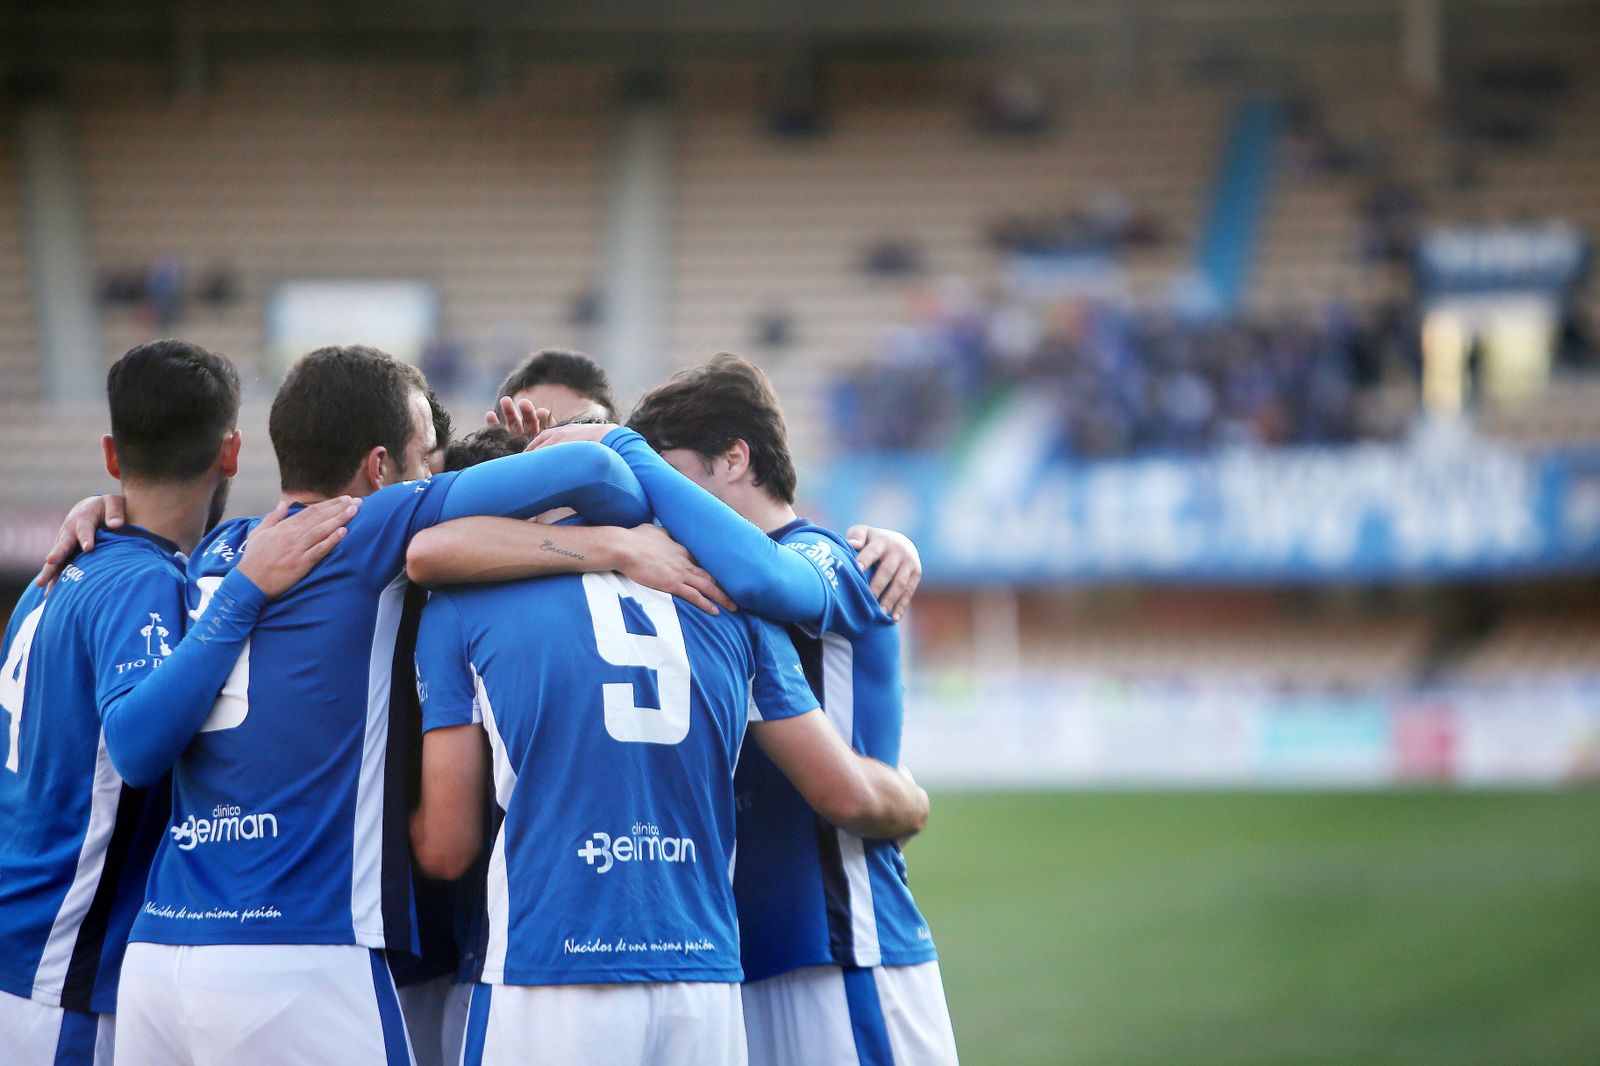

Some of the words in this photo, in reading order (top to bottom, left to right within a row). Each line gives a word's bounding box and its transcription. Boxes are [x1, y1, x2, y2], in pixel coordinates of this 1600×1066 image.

[582, 572, 691, 745] 9
[144, 901, 175, 918] Nacidos
[175, 905, 187, 919] de
[187, 911, 203, 920] una
[205, 907, 238, 919] misma
[240, 905, 282, 923] pasión
[564, 937, 612, 954] Nacidos
[615, 937, 626, 952] de
[628, 944, 648, 953] una
[650, 939, 682, 952] misma
[684, 938, 715, 955] pasión
